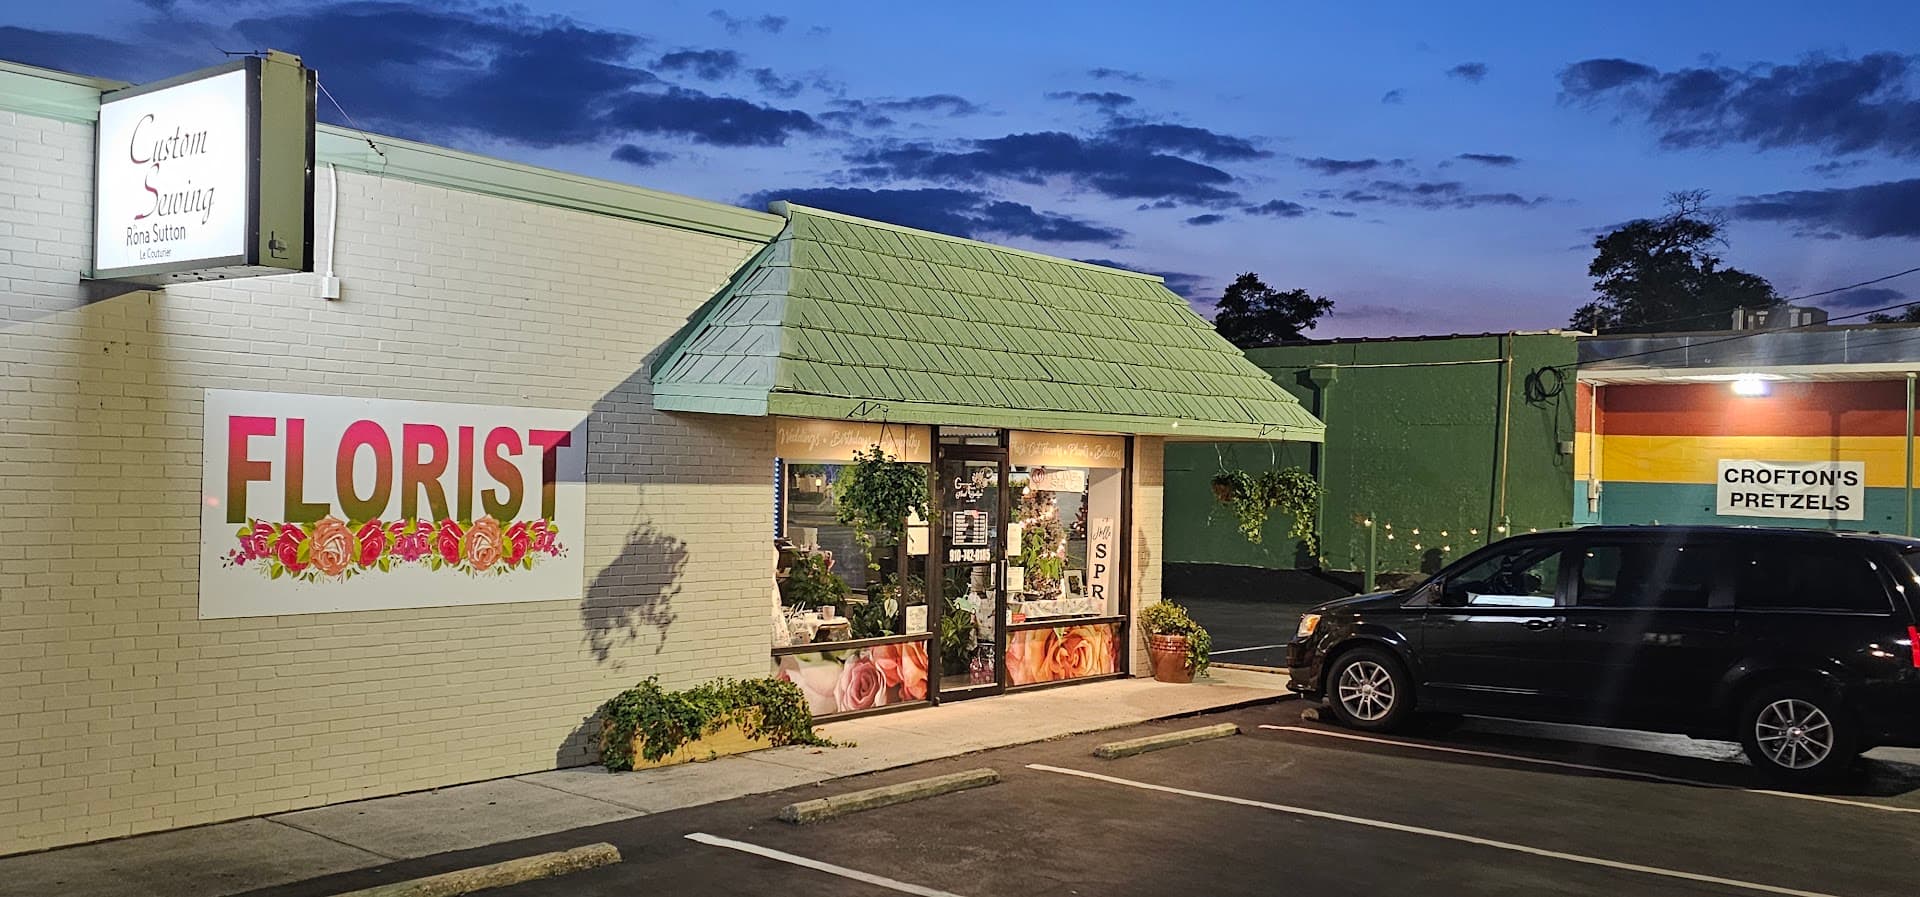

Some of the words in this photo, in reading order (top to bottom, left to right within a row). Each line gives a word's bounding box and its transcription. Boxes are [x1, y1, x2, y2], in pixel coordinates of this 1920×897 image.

[130, 113, 207, 164] Custom
[134, 163, 215, 225] Sewing
[126, 227, 150, 246] Rona
[153, 223, 186, 243] Sutton
[226, 415, 572, 524] FLORIST
[1724, 468, 1858, 486] CROFTON'S
[1730, 493, 1850, 511] PRETZELS
